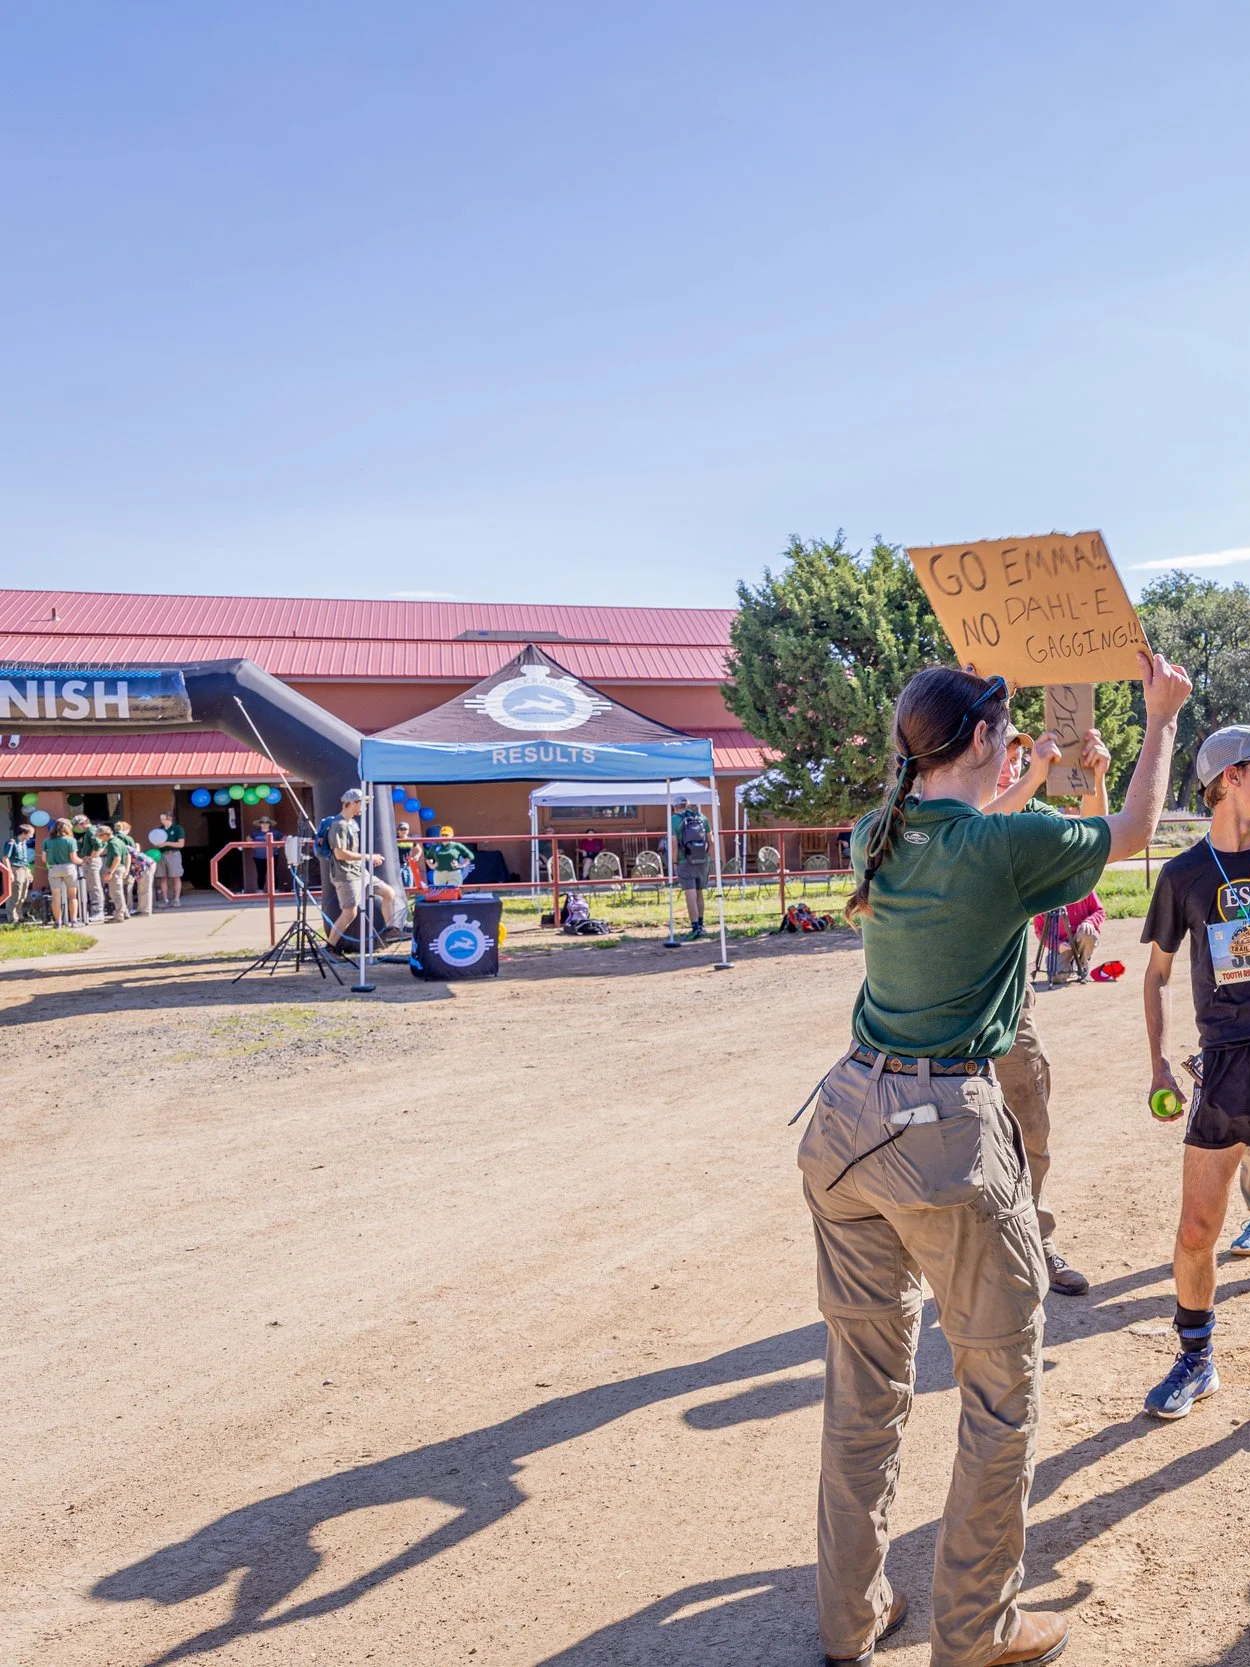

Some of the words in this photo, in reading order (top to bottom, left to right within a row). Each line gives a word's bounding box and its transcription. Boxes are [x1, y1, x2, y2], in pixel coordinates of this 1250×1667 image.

[929, 550, 987, 596] GO
[961, 612, 1001, 648] NO
[1004, 587, 1114, 626] DAHL-E
[1025, 620, 1141, 664] GAGGING!!
[0, 680, 131, 720] NISH
[492, 747, 596, 765] RESULTS
[1221, 971, 1243, 981] TOOTH
